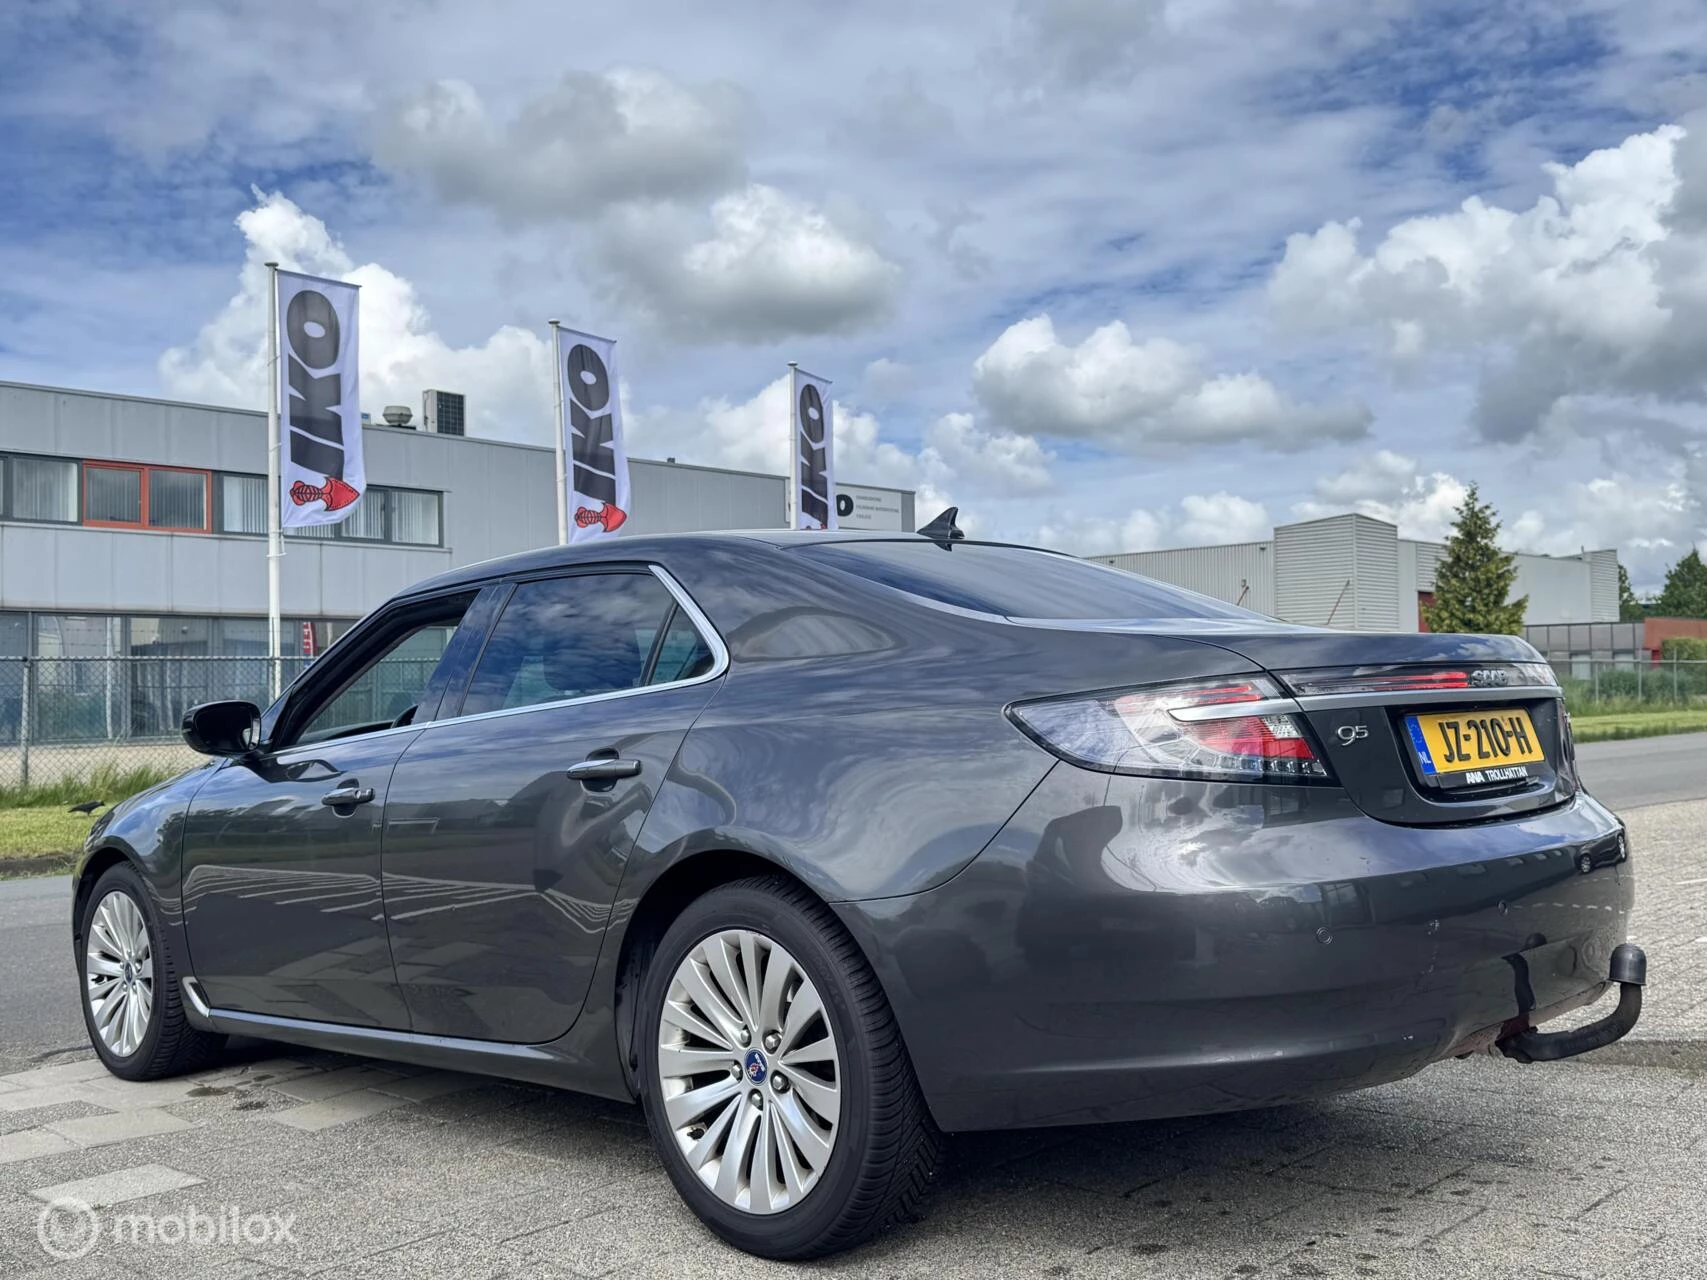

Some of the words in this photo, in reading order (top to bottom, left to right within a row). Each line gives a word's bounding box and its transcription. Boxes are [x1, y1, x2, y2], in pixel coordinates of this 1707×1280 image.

[286, 290, 345, 480] IKO
[567, 344, 616, 505] IKO
[800, 384, 829, 528] IKO
[1418, 751, 1432, 765] NL
[1438, 717, 1533, 763] JZ-210-H
[1465, 771, 1485, 784] ANA
